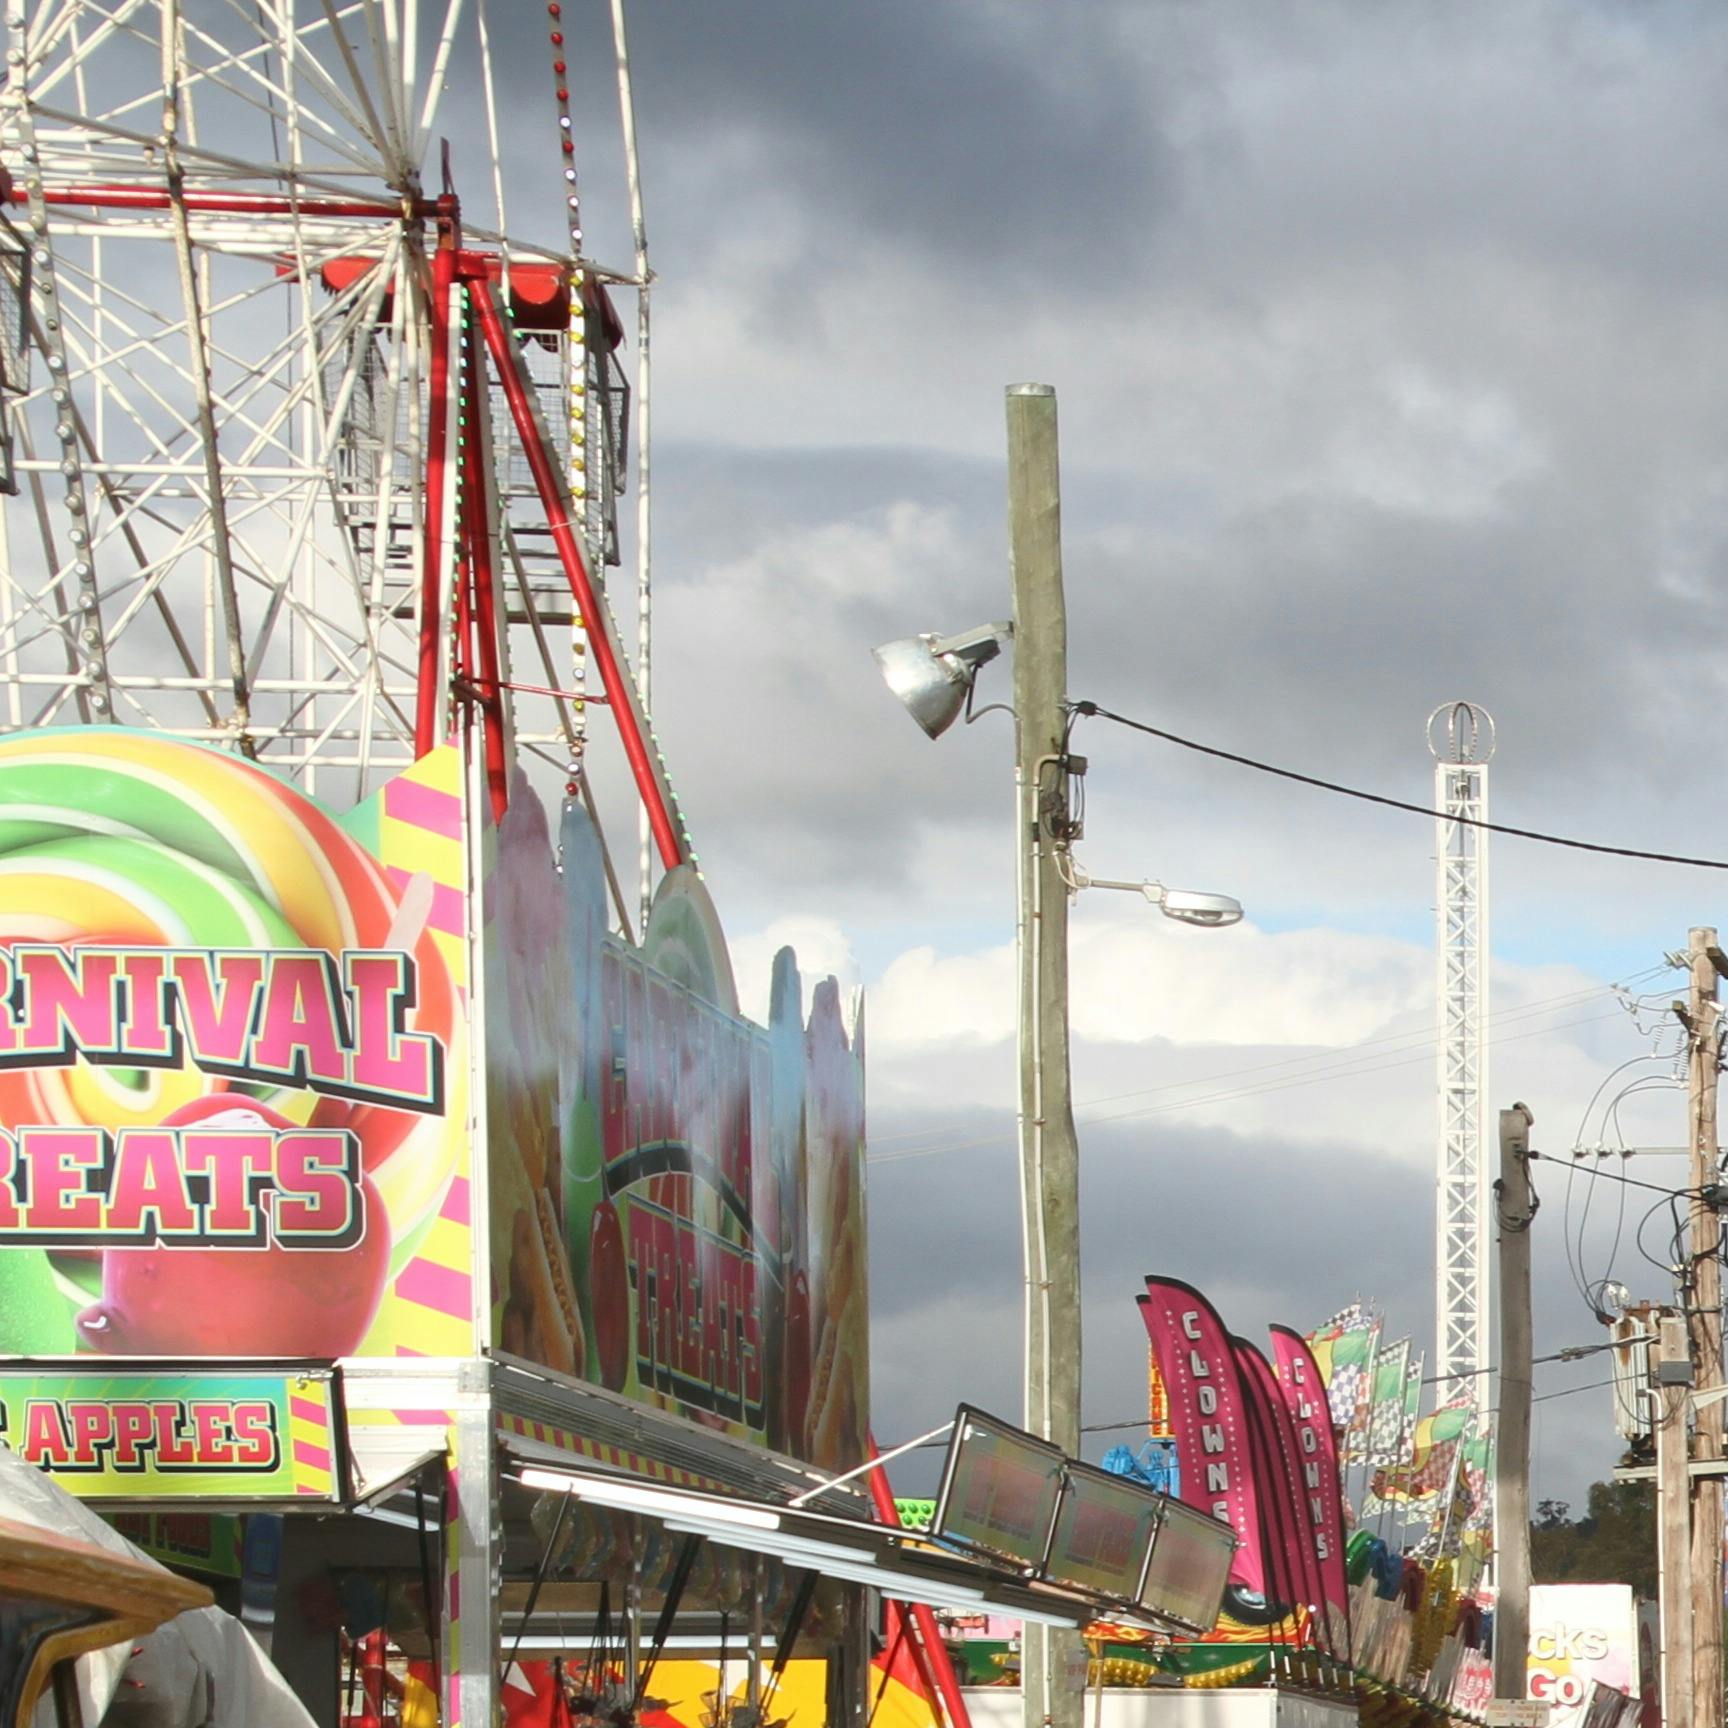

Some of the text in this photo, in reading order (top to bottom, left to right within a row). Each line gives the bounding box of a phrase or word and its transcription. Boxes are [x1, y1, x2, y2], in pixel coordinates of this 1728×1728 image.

[22, 1398, 281, 1474] APPLES
[1182, 1310, 1229, 1524] CLOWNS
[1293, 1357, 1328, 1560] CLOWNS
